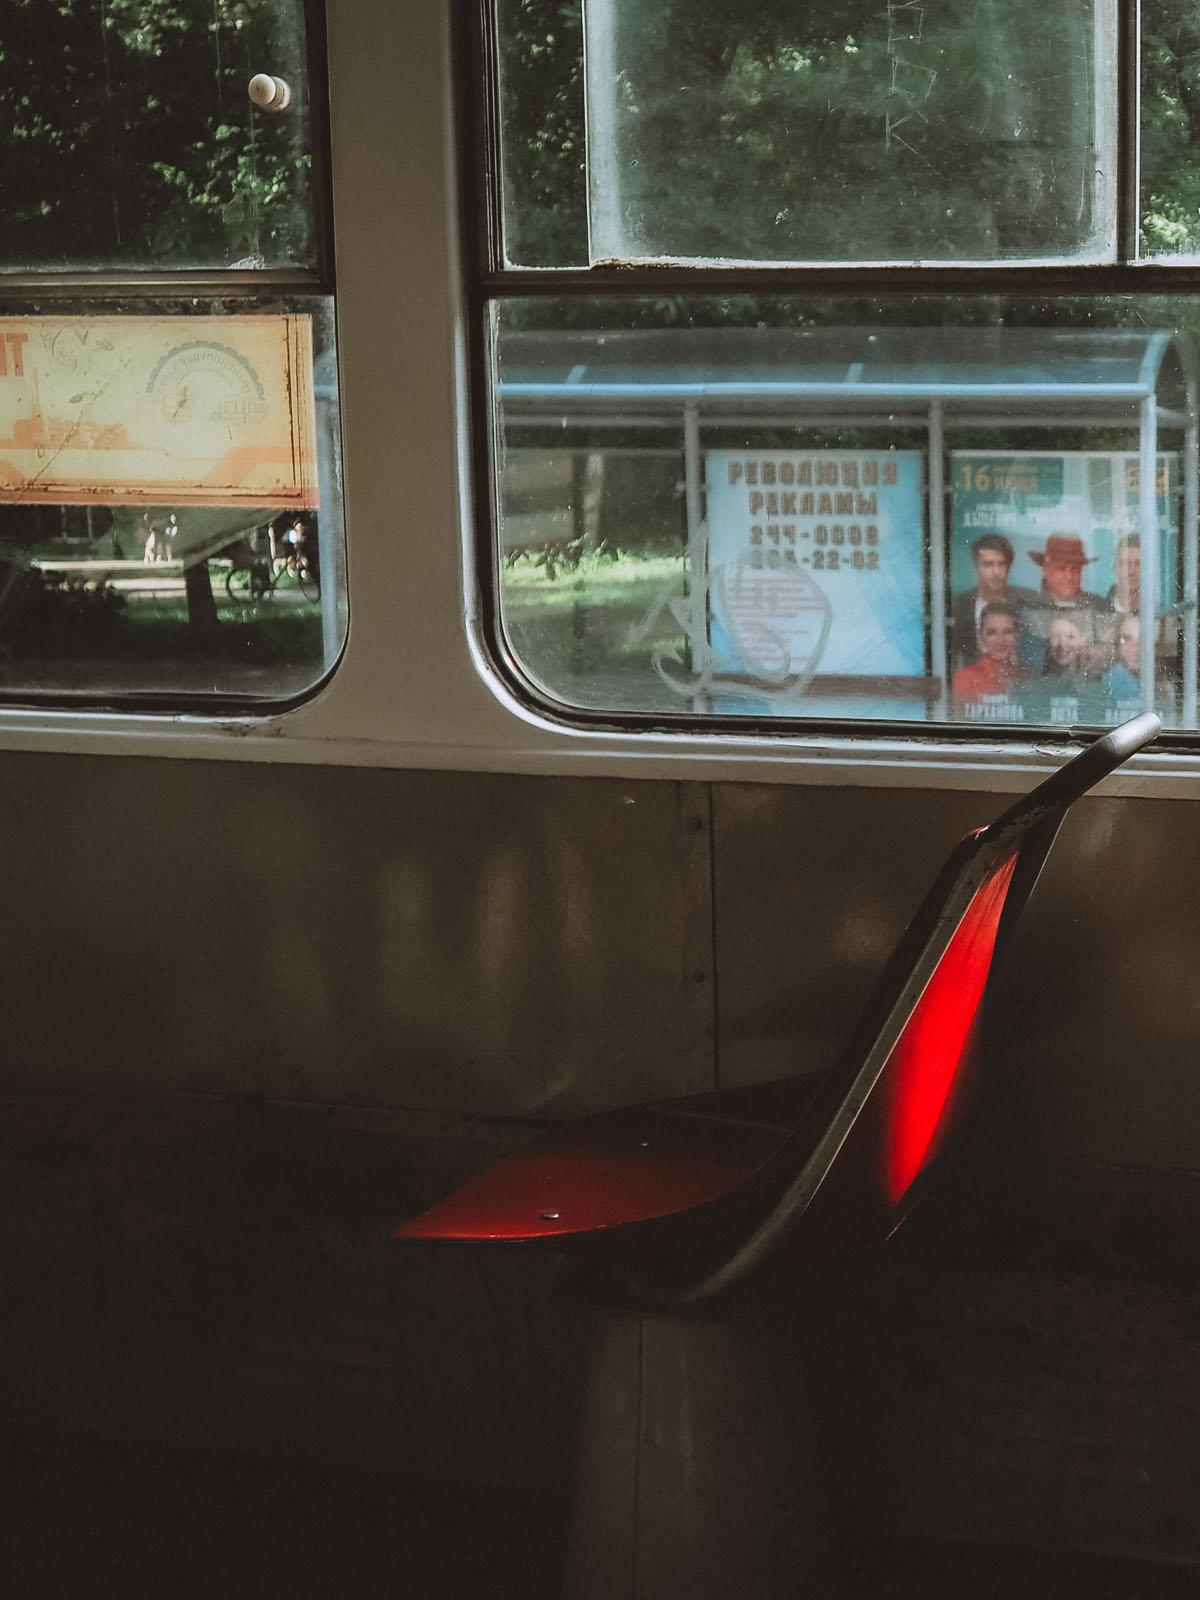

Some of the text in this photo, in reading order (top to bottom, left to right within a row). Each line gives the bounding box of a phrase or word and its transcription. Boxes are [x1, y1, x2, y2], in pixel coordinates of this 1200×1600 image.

[728, 461, 897, 488] РЕВОЛЮЦИЯ
[961, 464, 989, 492] 16
[749, 491, 877, 516] РЕКЛАМЫ
